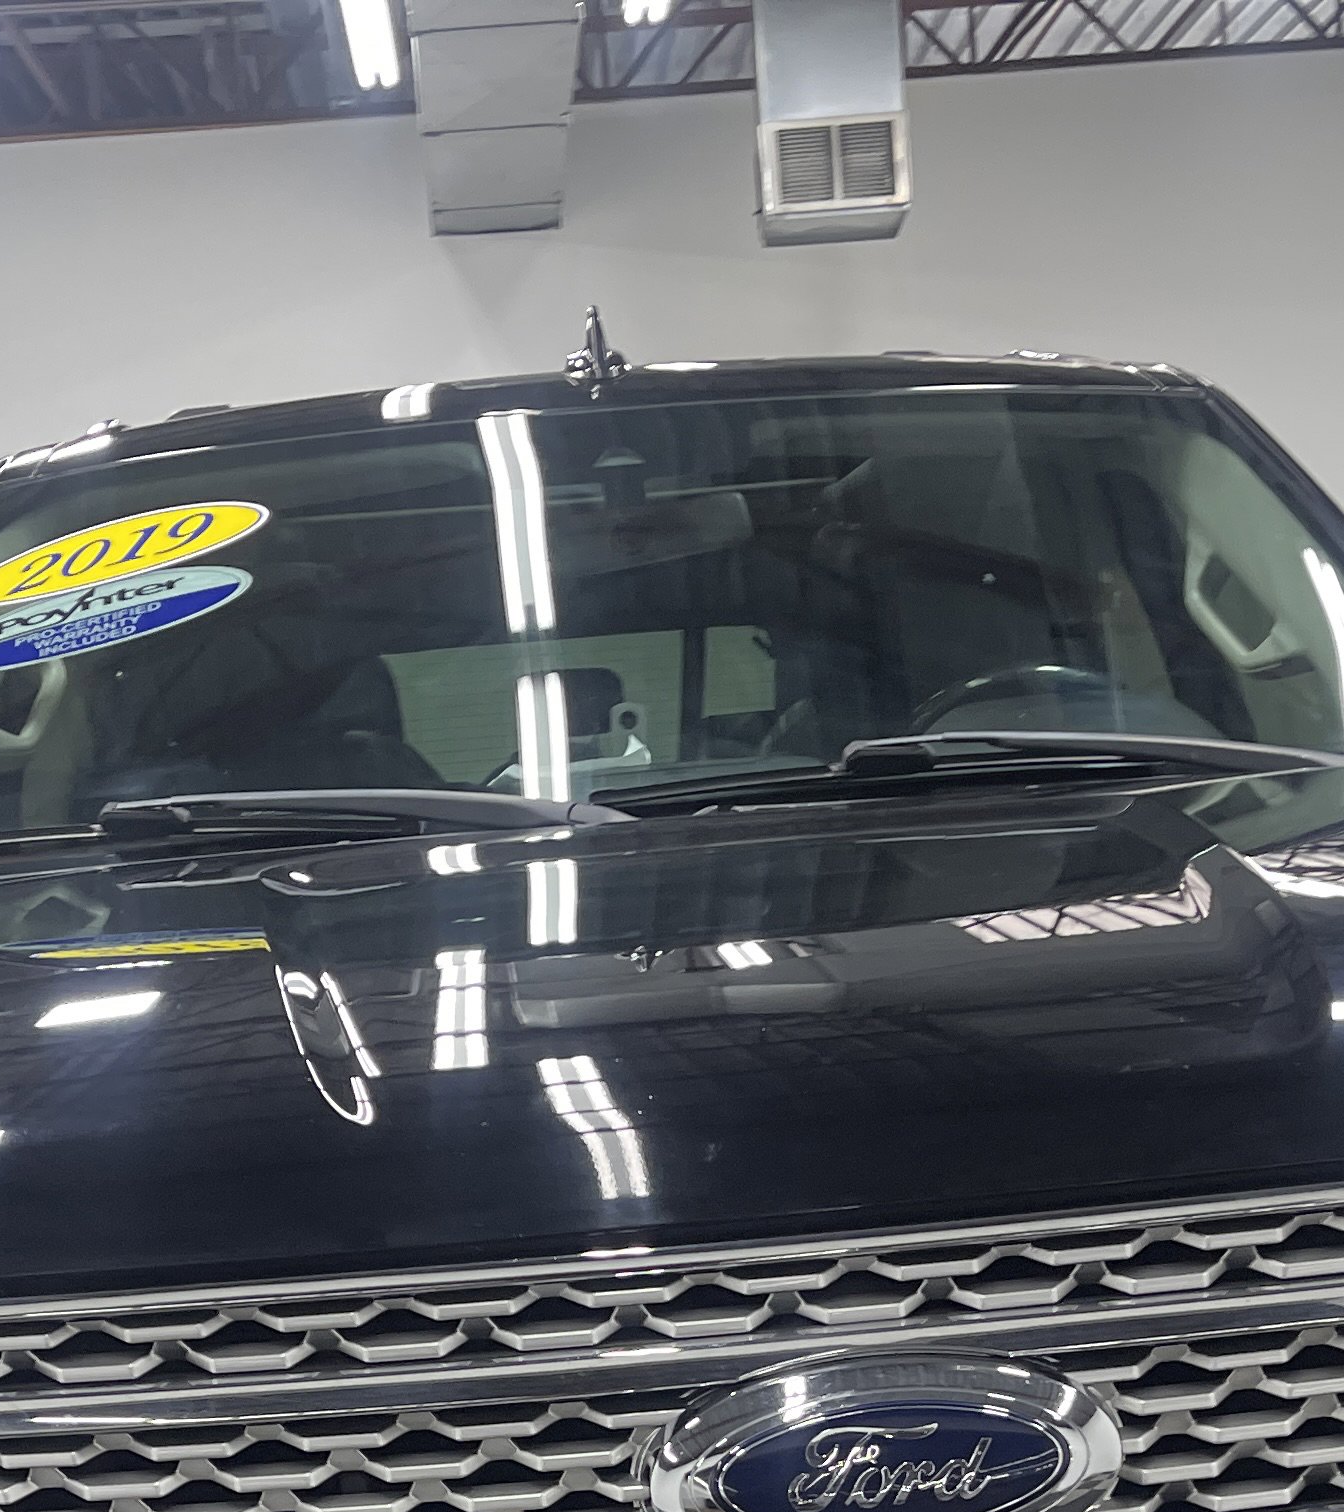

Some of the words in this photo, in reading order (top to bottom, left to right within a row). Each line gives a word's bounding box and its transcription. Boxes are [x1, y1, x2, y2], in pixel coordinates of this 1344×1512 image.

[5, 512, 214, 597] 2019
[14, 601, 162, 648] PRO-CERTIFIED
[34, 615, 144, 650] WARRANTY
[38, 625, 137, 657] INCLUDED
